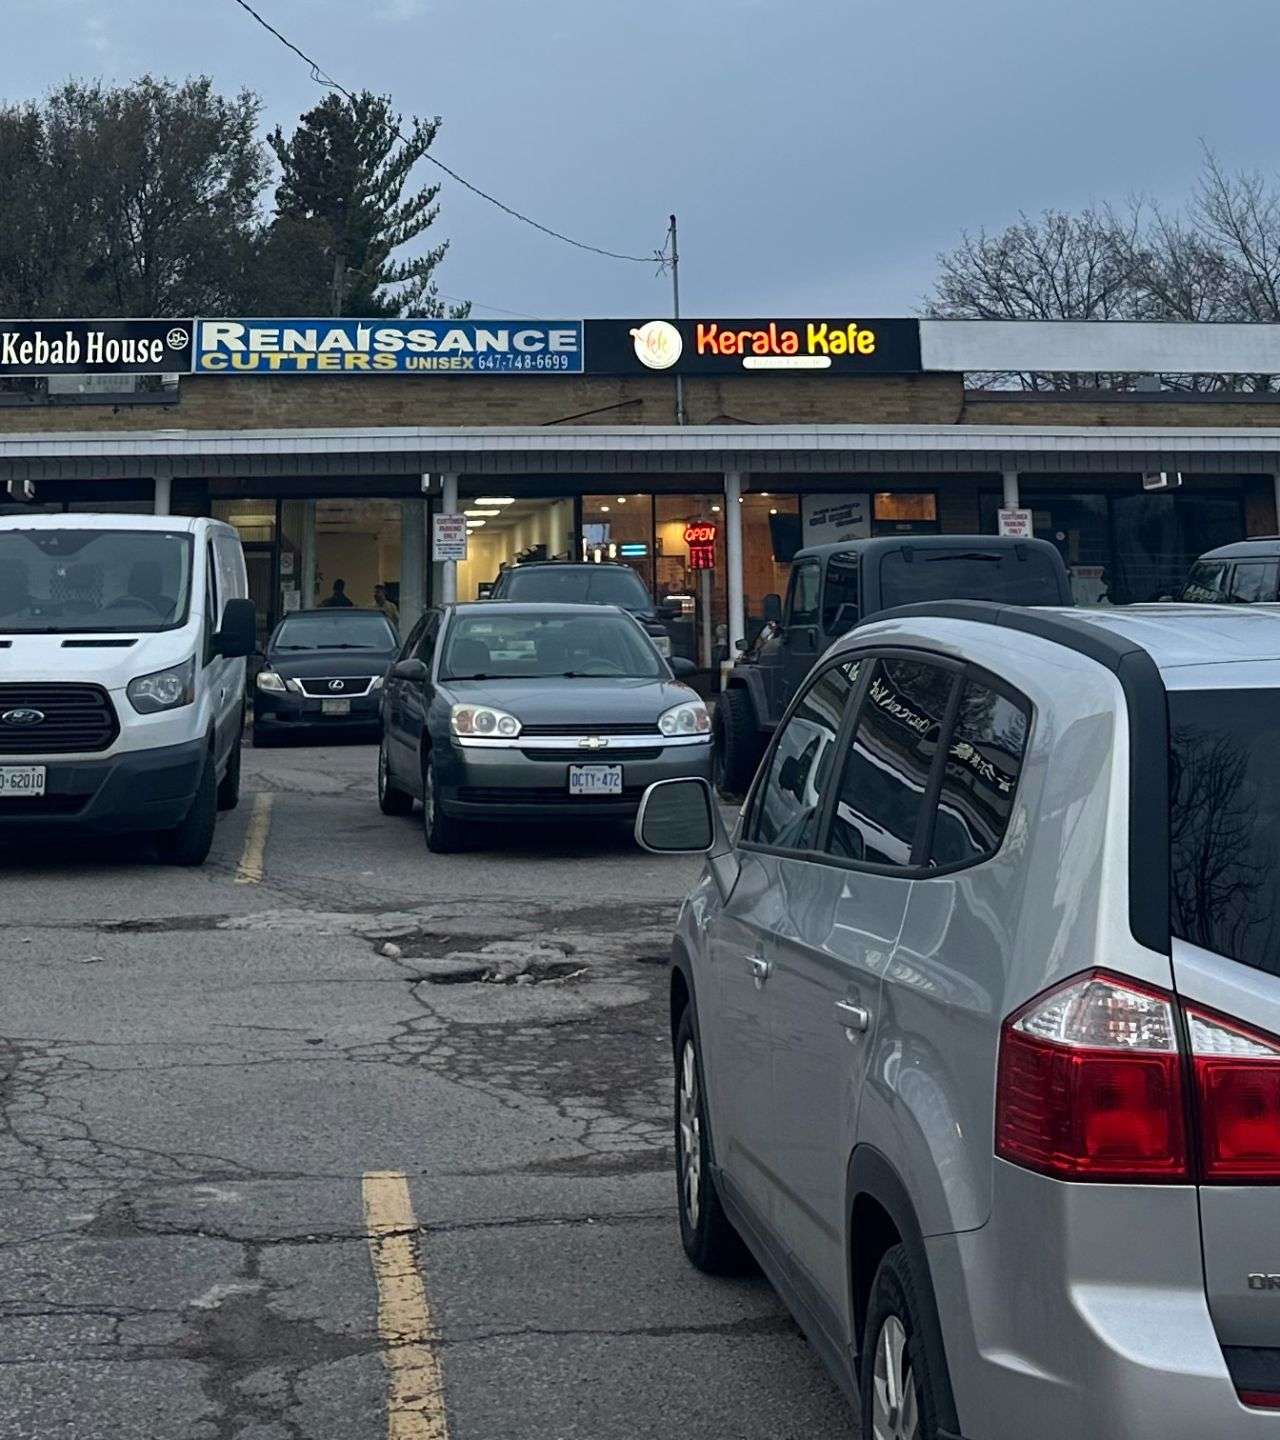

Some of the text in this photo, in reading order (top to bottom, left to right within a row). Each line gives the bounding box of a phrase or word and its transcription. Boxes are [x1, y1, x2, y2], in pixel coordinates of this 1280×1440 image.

[1, 331, 80, 365] Kebab
[86, 331, 164, 363] House
[201, 322, 579, 352] RENAISSANCE
[696, 322, 799, 355] Kerala
[807, 322, 876, 355] Kafe
[201, 351, 569, 370] CUTTERS UNISEX 647-748-6699
[685, 527, 716, 541] OPEN
